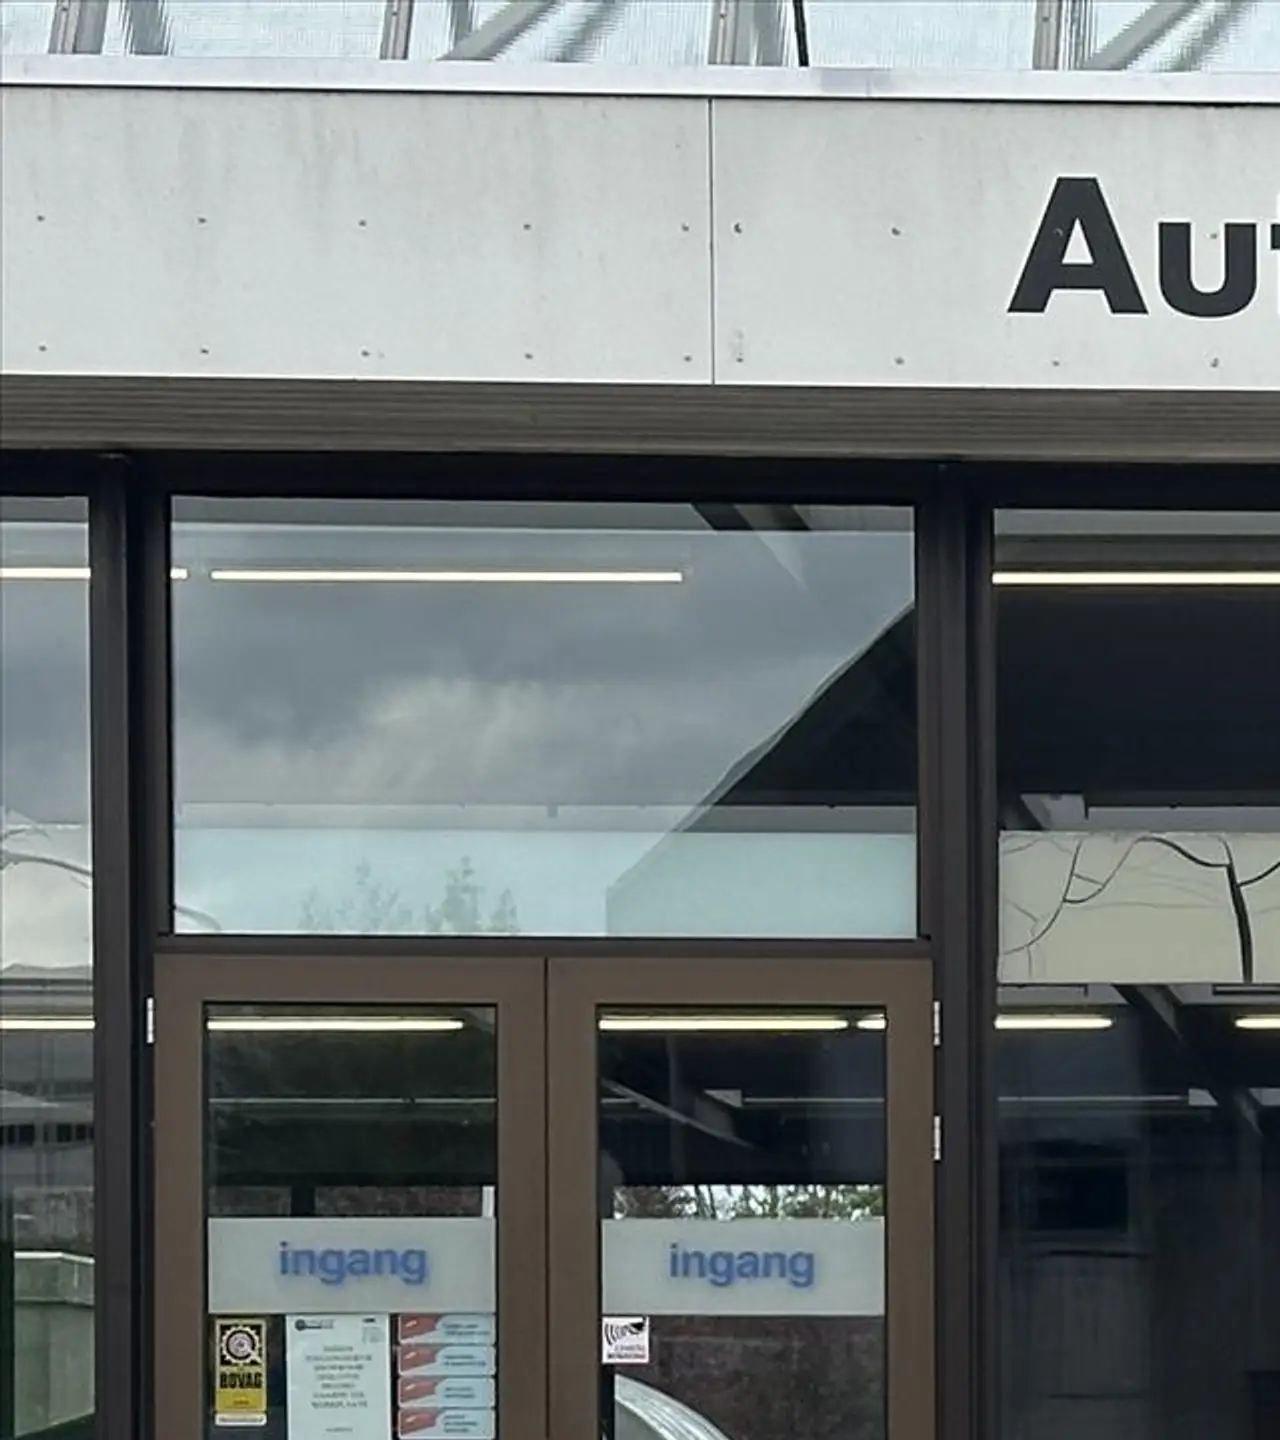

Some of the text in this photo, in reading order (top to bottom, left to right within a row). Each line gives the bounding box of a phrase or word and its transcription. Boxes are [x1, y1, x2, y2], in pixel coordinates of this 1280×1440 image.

[278, 1242, 428, 1285] ingang
[669, 1243, 815, 1287] ingang
[220, 1372, 263, 1389] BOVAG
